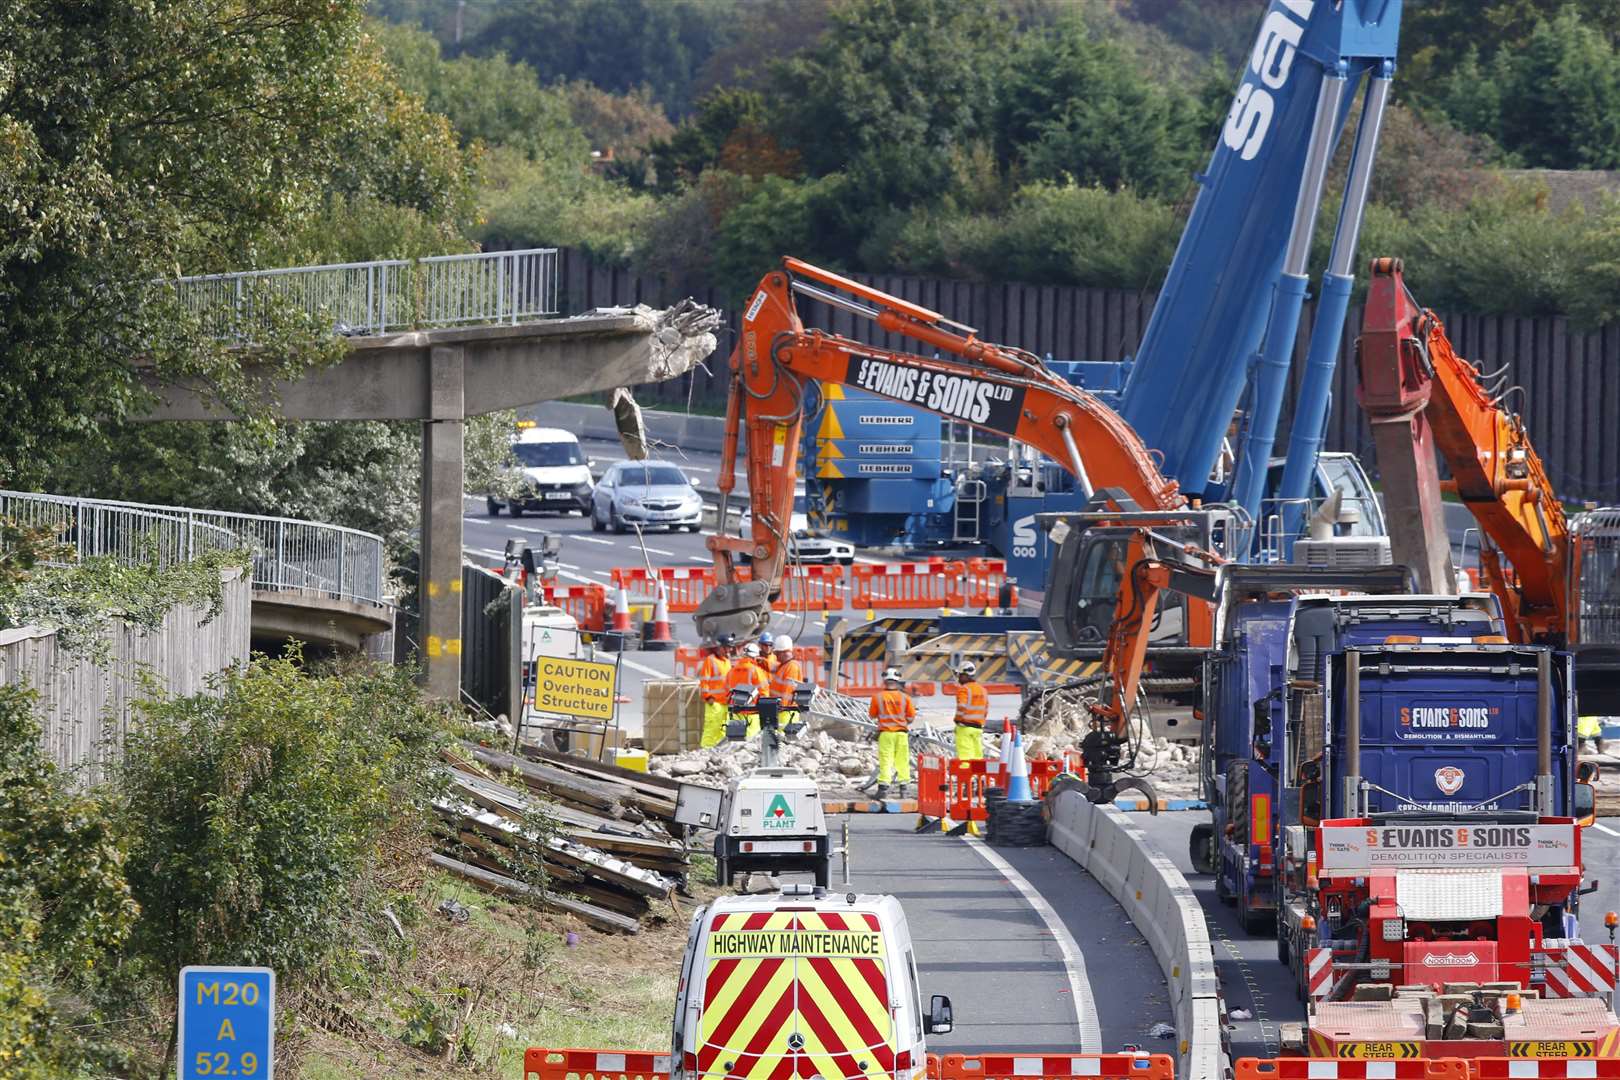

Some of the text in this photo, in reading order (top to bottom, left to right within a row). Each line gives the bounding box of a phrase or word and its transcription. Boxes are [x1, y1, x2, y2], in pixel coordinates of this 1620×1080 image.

[858, 359, 1014, 424] S EVANS & SONS LTD
[860, 416, 912, 424] LIEBHERR
[859, 445, 912, 453] LIEBHERR
[859, 464, 911, 473] LIEBHERR
[544, 664, 610, 682] CAUTION
[543, 680, 609, 698] Overhead
[542, 694, 608, 712] Structure
[1401, 707, 1410, 726] S
[1412, 707, 1449, 728] EVANS
[1450, 707, 1458, 726] &
[1458, 707, 1488, 728] SONS
[763, 820, 795, 828] PLANT
[1366, 828, 1378, 847] S
[1382, 828, 1453, 848] EVANS
[1457, 828, 1468, 847] &
[1473, 828, 1531, 847] SONS
[1371, 852, 1528, 861] DEMOLITION SPECIALISTS
[714, 934, 879, 954] HIGHWAY MAINTENANCE
[197, 982, 259, 1006] M20
[217, 1018, 236, 1041] A
[1365, 1043, 1393, 1052] REAR
[1538, 1042, 1566, 1050] REAR
[196, 1052, 258, 1075] 52.9
